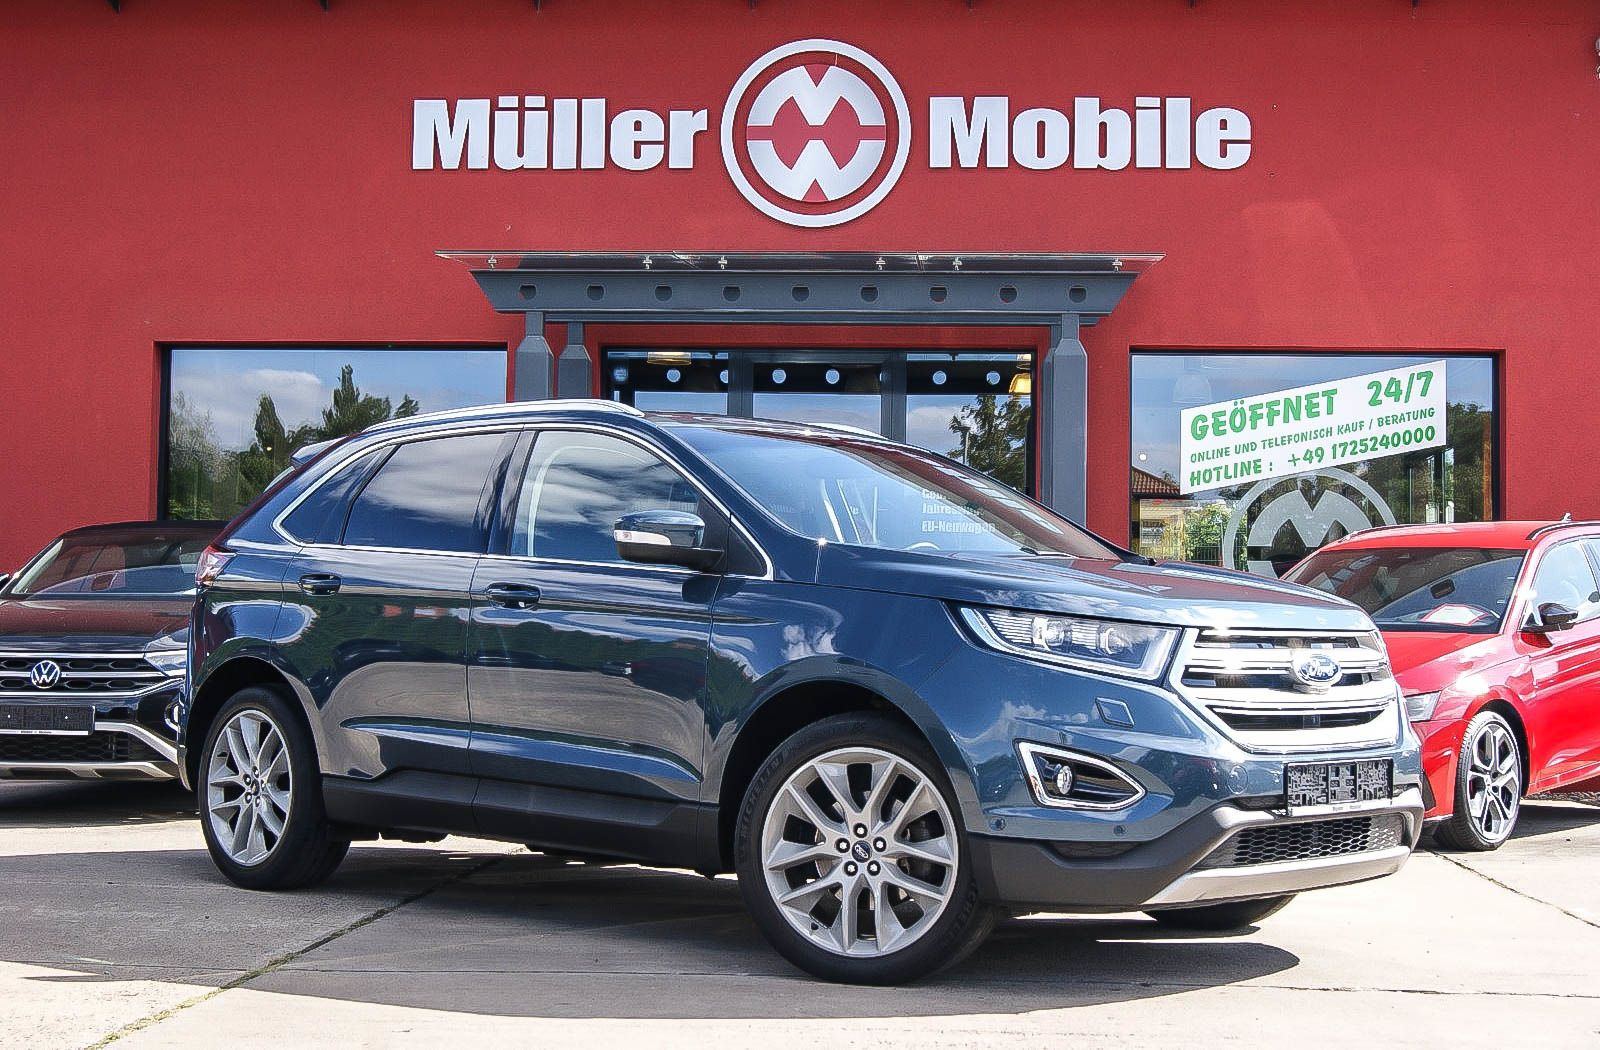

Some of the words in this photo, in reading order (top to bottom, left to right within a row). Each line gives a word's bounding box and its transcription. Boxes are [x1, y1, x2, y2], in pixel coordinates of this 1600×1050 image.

[412, 96, 708, 171] Müller
[929, 96, 1252, 171] Mobile
[1190, 388, 1338, 441] GEÖFFNET
[1367, 370, 1434, 407] 24/7
[1190, 446, 1231, 463] ONLINE
[1234, 441, 1258, 455] UND
[1260, 426, 1333, 450] TELEFONISCH
[1337, 420, 1365, 435] KAUF
[1377, 407, 1435, 427] BERATUNG
[1189, 458, 1262, 487] HOTLINE
[1287, 446, 1325, 467] +49
[1331, 425, 1436, 460] 1725240000
